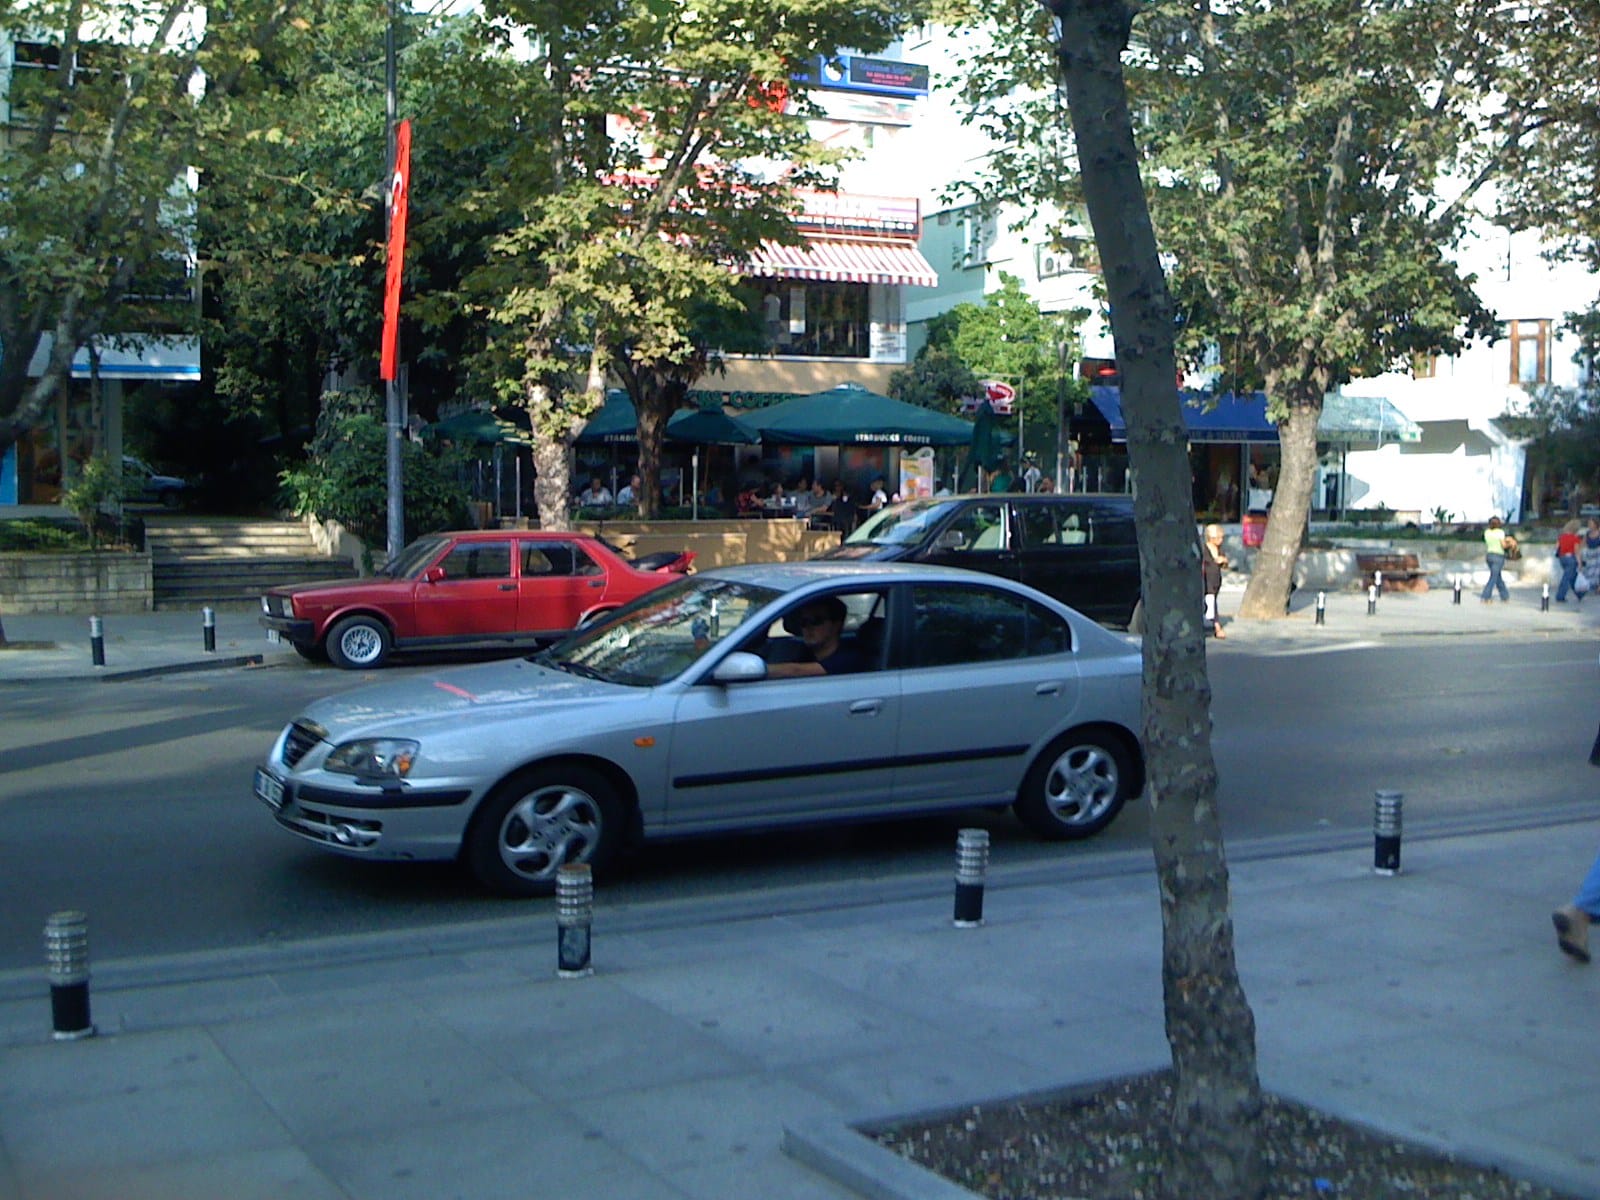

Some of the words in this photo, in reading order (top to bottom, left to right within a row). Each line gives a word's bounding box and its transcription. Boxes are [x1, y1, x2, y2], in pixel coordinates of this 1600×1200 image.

[604, 434, 640, 442] STARBU
[855, 433, 900, 442] STARBUCKS
[903, 434, 930, 444] COFFEE
